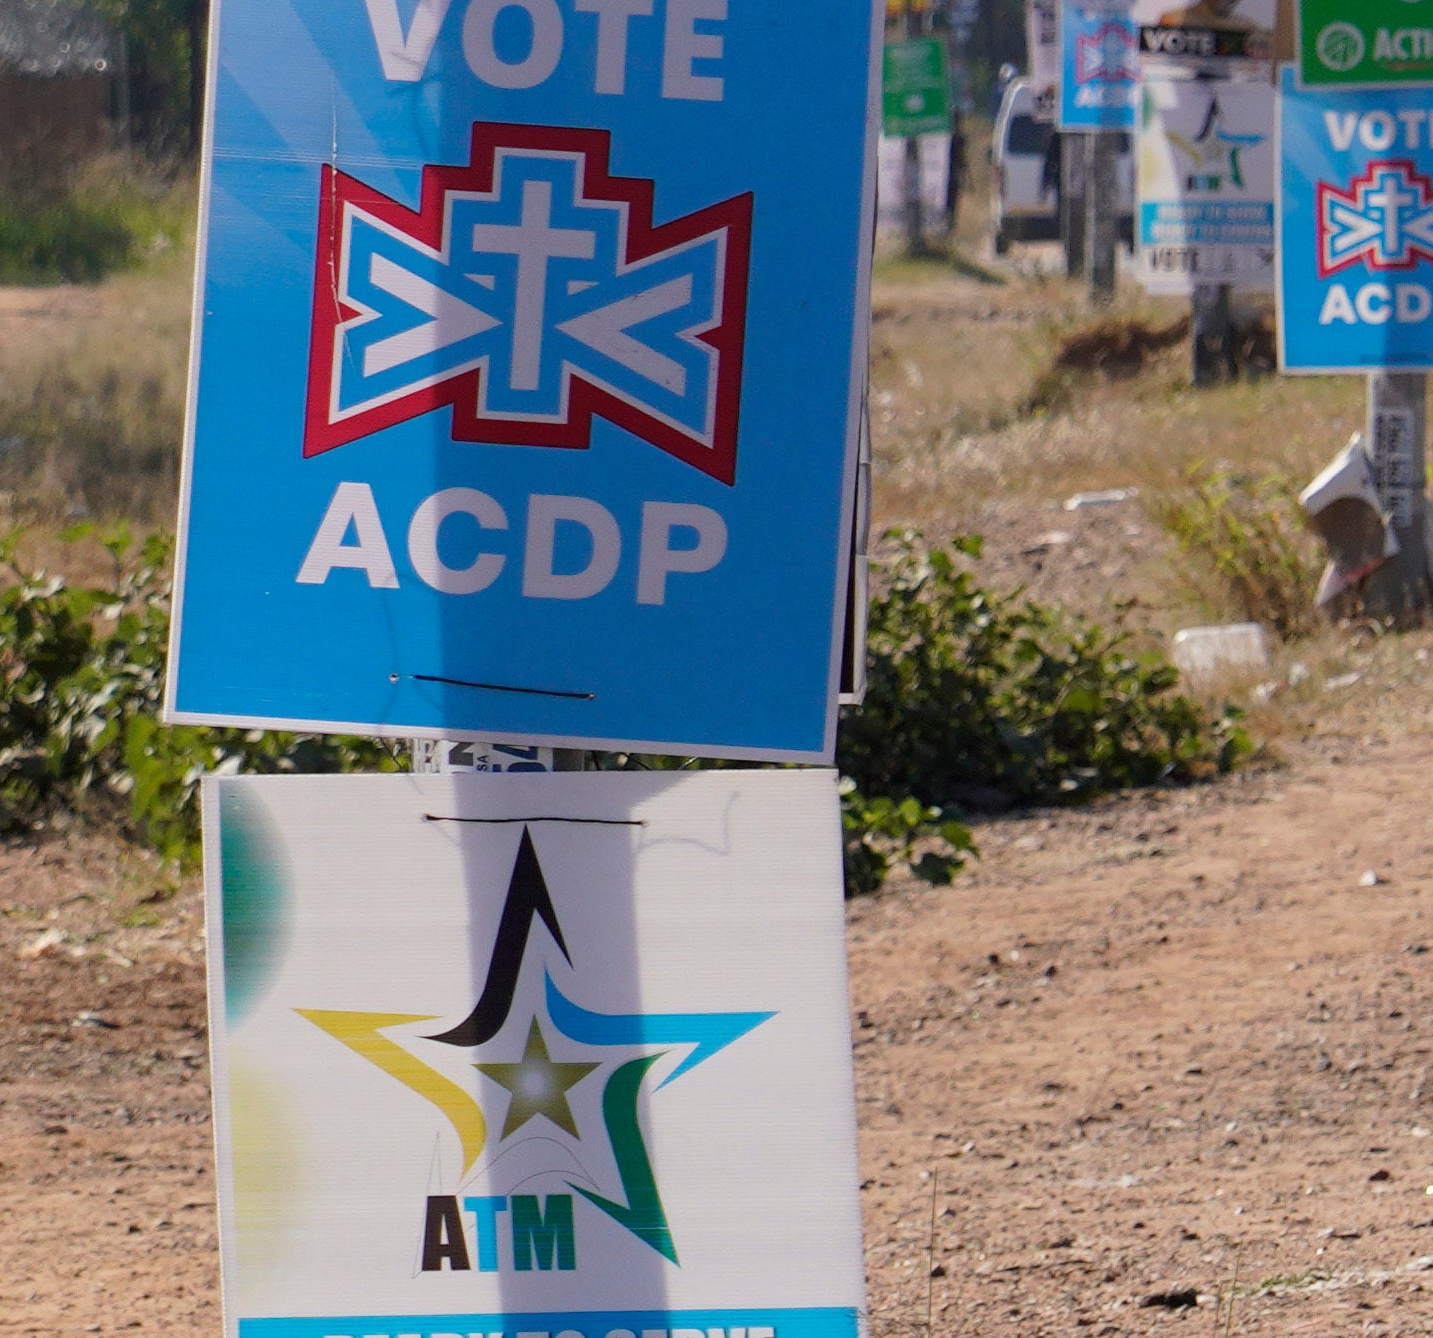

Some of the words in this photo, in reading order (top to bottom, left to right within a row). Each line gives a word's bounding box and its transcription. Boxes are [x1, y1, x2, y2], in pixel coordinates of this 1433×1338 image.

[1142, 29, 1216, 54] VOTE
[294, 479, 730, 606] ACDP
[421, 1193, 578, 1272] ATM
